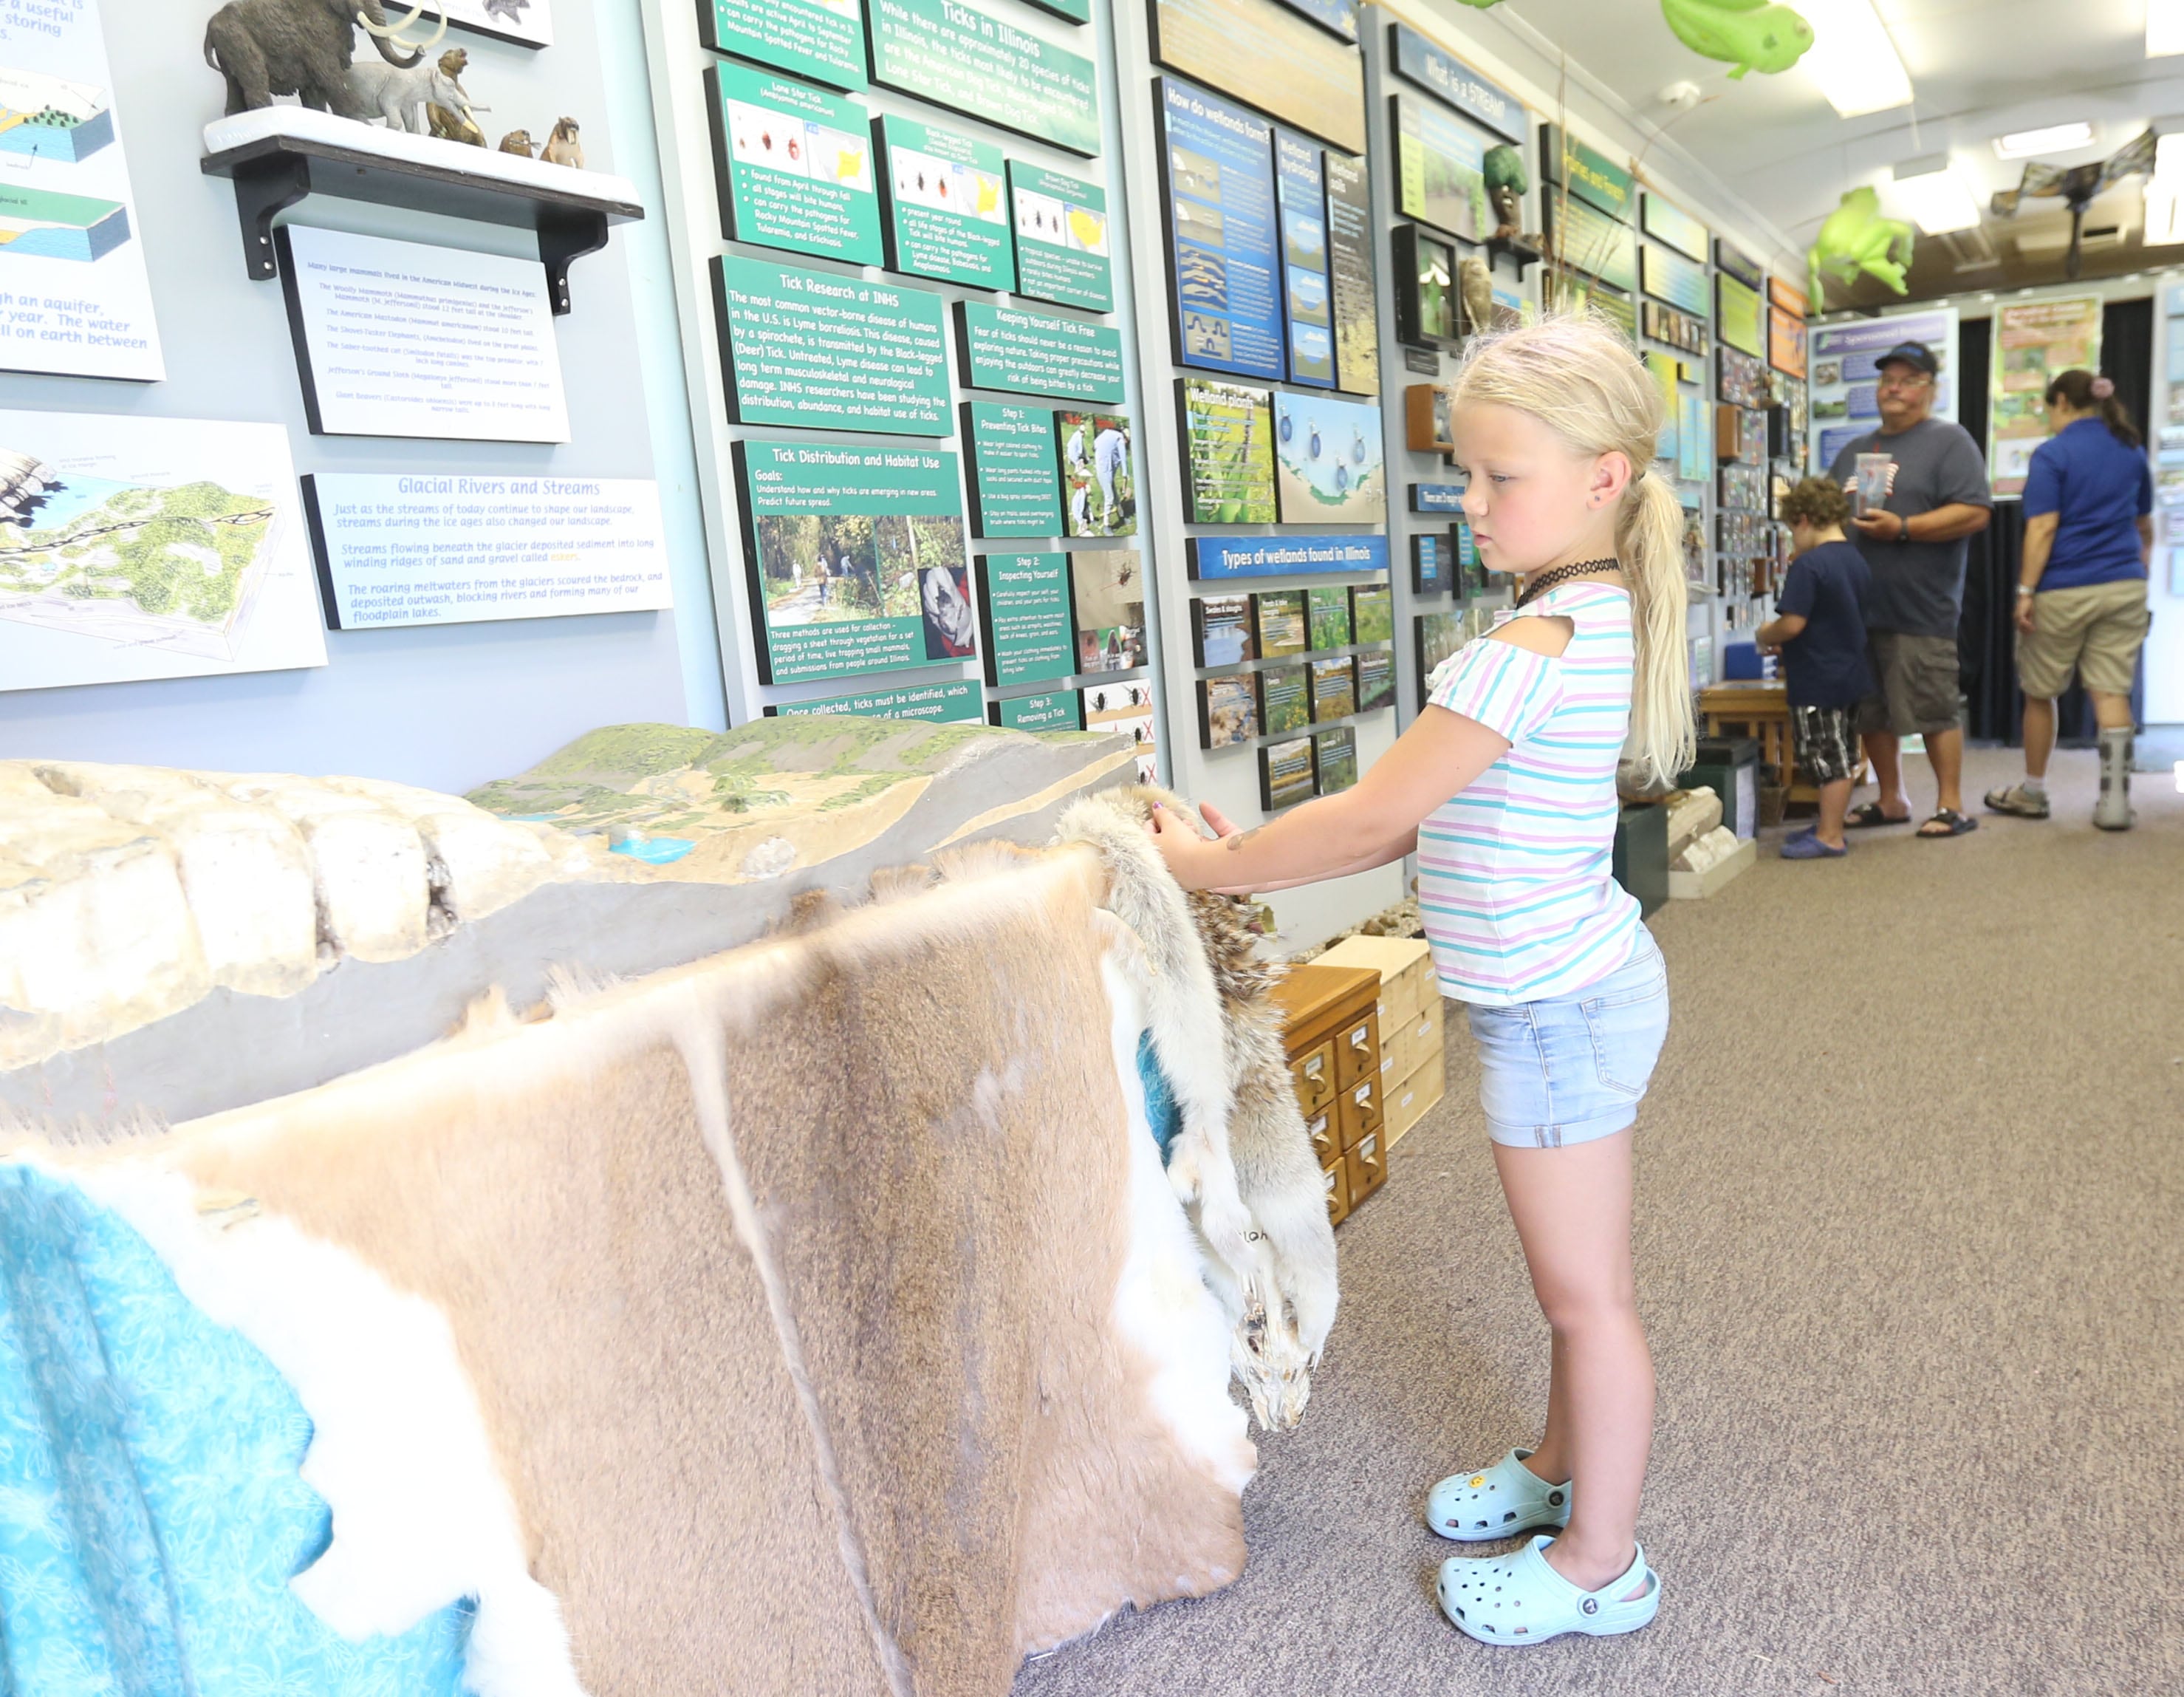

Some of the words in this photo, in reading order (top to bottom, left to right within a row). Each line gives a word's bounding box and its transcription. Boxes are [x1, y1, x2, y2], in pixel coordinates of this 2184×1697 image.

[27, 2, 74, 23] useful
[6, 13, 61, 38] storing
[942, 2, 976, 31] Ticks
[981, 16, 994, 38] in
[998, 24, 1041, 58] Illinois
[880, 1, 909, 21] While
[912, 12, 938, 33] there
[940, 27, 956, 41] are
[959, 32, 1016, 67] approximately
[1019, 55, 1030, 70] 20
[1031, 61, 1059, 83] species
[1061, 73, 1070, 86] of
[1425, 53, 1448, 86] What
[1451, 70, 1459, 92] is
[1462, 83, 1468, 97] a
[772, 82, 790, 95] Lone
[792, 86, 807, 99] Star
[808, 92, 822, 104] Tick
[1168, 86, 1190, 111] How
[1190, 98, 1205, 116] do
[1206, 108, 1245, 134] wetlands
[1245, 126, 1270, 144] form?
[1280, 137, 1312, 163] Wetland
[779, 274, 803, 290] Tick
[807, 279, 856, 299] Research
[859, 288, 869, 301] at
[874, 291, 899, 307] INHS
[18, 296, 38, 307] an
[44, 298, 104, 316] aquifer,
[730, 290, 747, 304] The
[750, 294, 771, 307] most
[775, 299, 809, 313] common
[812, 305, 866, 323] vector-borne
[868, 313, 896, 327] disease
[899, 317, 907, 328] of
[909, 318, 937, 333] humans
[8, 310, 48, 324] year.
[58, 313, 83, 328] The
[88, 318, 131, 332] water
[731, 307, 740, 319] in
[744, 310, 759, 322] the
[762, 313, 781, 326] U.S.
[784, 315, 791, 327] is
[793, 317, 816, 332] Lyme
[863, 327, 880, 340] This
[883, 331, 913, 346] disease,
[914, 335, 940, 348] caused
[996, 310, 1029, 329] Keeping
[1030, 316, 1061, 331] Yourself
[1062, 321, 1077, 333] Tick
[1079, 326, 1095, 337] Free
[16, 327, 35, 338] on
[41, 330, 83, 344] earth
[88, 332, 148, 349] between
[1191, 387, 1227, 405] Wetland
[1228, 394, 1254, 409] plants
[1002, 408, 1017, 419] Step
[981, 420, 1016, 434] Preventing
[1017, 423, 1030, 432] Tick
[1031, 423, 1047, 434] Bites
[773, 448, 795, 462] Tick
[799, 450, 860, 466] Distribution
[864, 454, 882, 466] and
[885, 455, 919, 468] Habitat
[922, 457, 940, 468] Use
[755, 469, 782, 481] Goals:
[398, 477, 453, 494] Glacial
[459, 478, 505, 494] Rivers
[510, 480, 538, 495] and
[543, 480, 600, 496] Streams
[756, 485, 795, 494] Understand
[797, 486, 811, 494] how
[813, 486, 825, 495] and
[827, 487, 841, 496] why
[843, 487, 857, 495] ticks
[871, 488, 899, 498] emerging
[334, 504, 357, 516] Just
[360, 505, 373, 514] as
[376, 504, 394, 514] the
[397, 504, 439, 514] streams
[442, 504, 455, 516] of
[456, 505, 485, 517] today
[488, 505, 530, 514] continue
[532, 505, 541, 514] to
[544, 505, 570, 517] shape
[573, 506, 588, 514] our
[590, 505, 635, 516] landscape,
[758, 496, 782, 506] Predict
[786, 497, 807, 506] future
[809, 498, 832, 508] spread.
[337, 517, 382, 527] streams
[385, 517, 420, 528] during
[423, 517, 440, 527] the
[443, 517, 457, 527] ice
[460, 519, 483, 528] ages
[486, 516, 505, 526] also
[508, 516, 547, 527] changed
[550, 518, 564, 526] our
[567, 516, 612, 527] landscape.
[1016, 557, 1032, 567] Step
[1222, 549, 1252, 569] Types
[1254, 550, 1264, 564] of
[1266, 548, 1307, 563] wetlands
[1309, 547, 1334, 561] found
[1335, 547, 1343, 559] in
[1346, 545, 1370, 559] Illinois
[999, 570, 1033, 582] Inspecting
[1033, 568, 1059, 579] Yourself
[354, 610, 409, 623] floodplain
[412, 608, 442, 618] lakes.
[812, 701, 852, 715] collected,
[854, 698, 873, 710] ticks
[875, 696, 894, 706] must
[897, 694, 906, 704] be
[908, 690, 945, 703] identified,
[947, 686, 968, 698] which
[1030, 699, 1044, 709] Step
[1018, 713, 1047, 725] Removing
[1053, 708, 1065, 717] Tick
